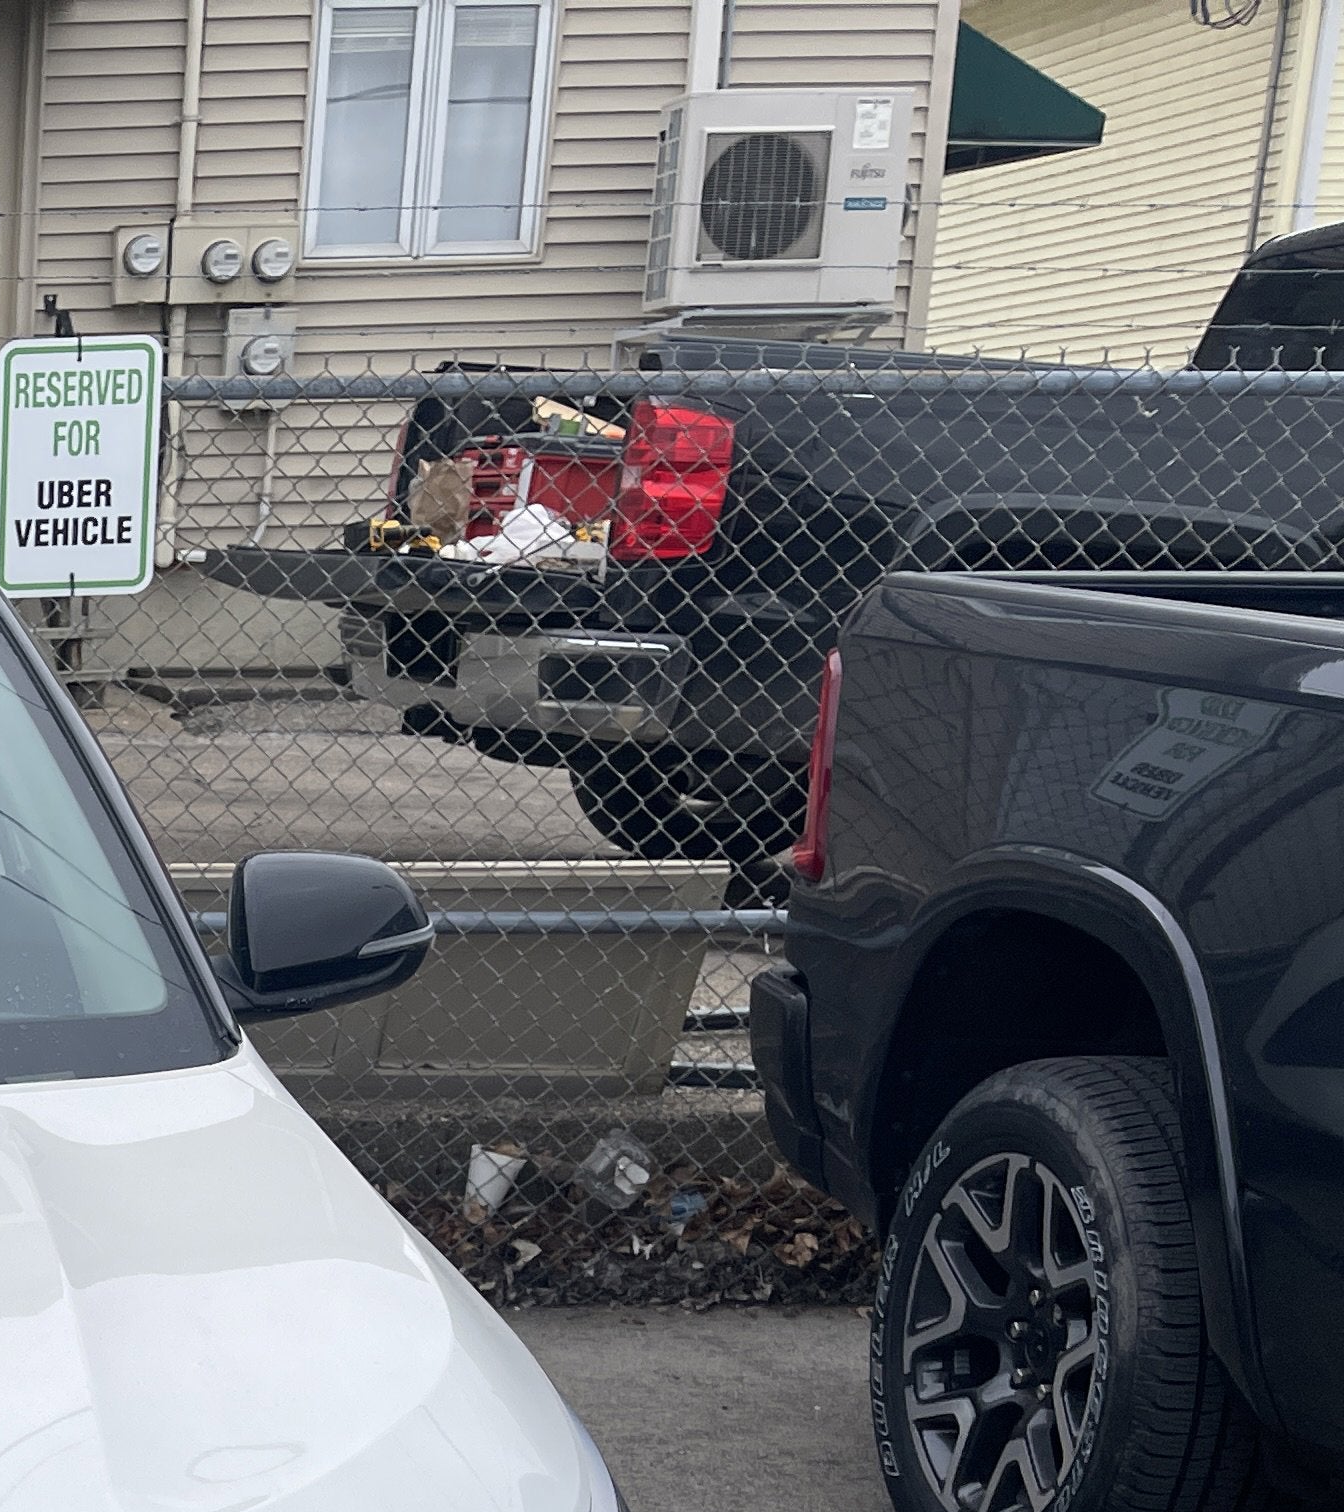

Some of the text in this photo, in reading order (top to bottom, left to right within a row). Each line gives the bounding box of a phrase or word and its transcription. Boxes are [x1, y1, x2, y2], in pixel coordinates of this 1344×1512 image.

[14, 368, 143, 409] RESERVED
[52, 419, 101, 457] FOR
[37, 479, 112, 510] UBER
[15, 515, 133, 548] VEHICLE
